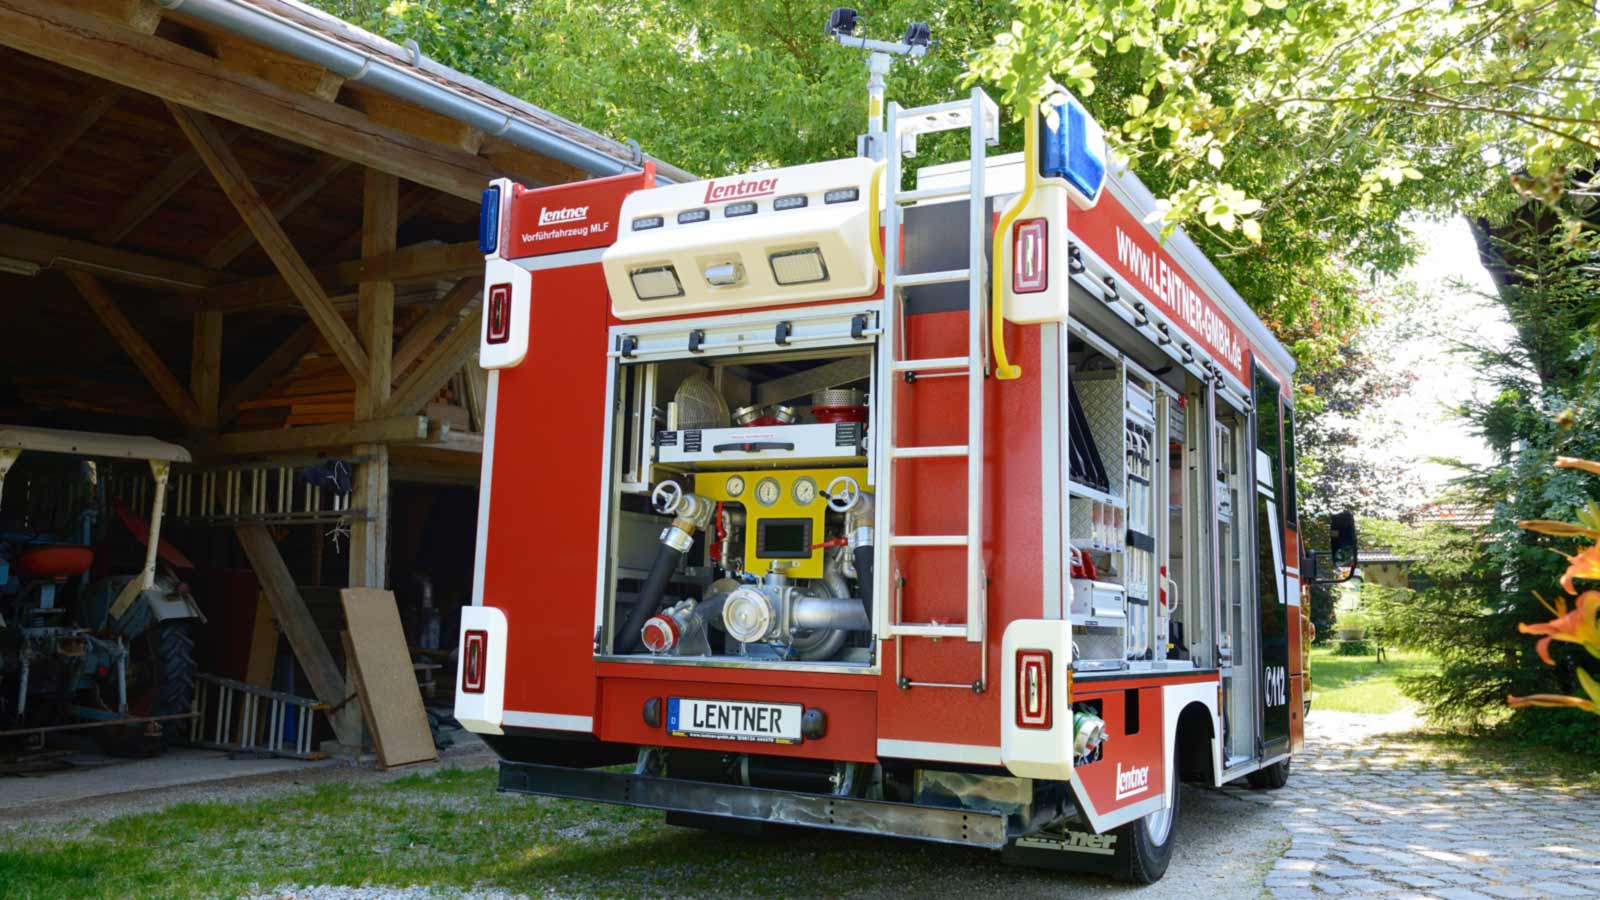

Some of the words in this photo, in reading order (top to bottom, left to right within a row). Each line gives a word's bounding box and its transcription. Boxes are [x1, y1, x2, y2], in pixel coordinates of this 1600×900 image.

[703, 179, 779, 204] Lentner
[538, 206, 589, 226] Lentner
[522, 226, 588, 243] Vorführfahrzeug
[590, 222, 609, 233] MLF
[693, 703, 783, 733] LENTNER
[1116, 762, 1149, 800] Lentner
